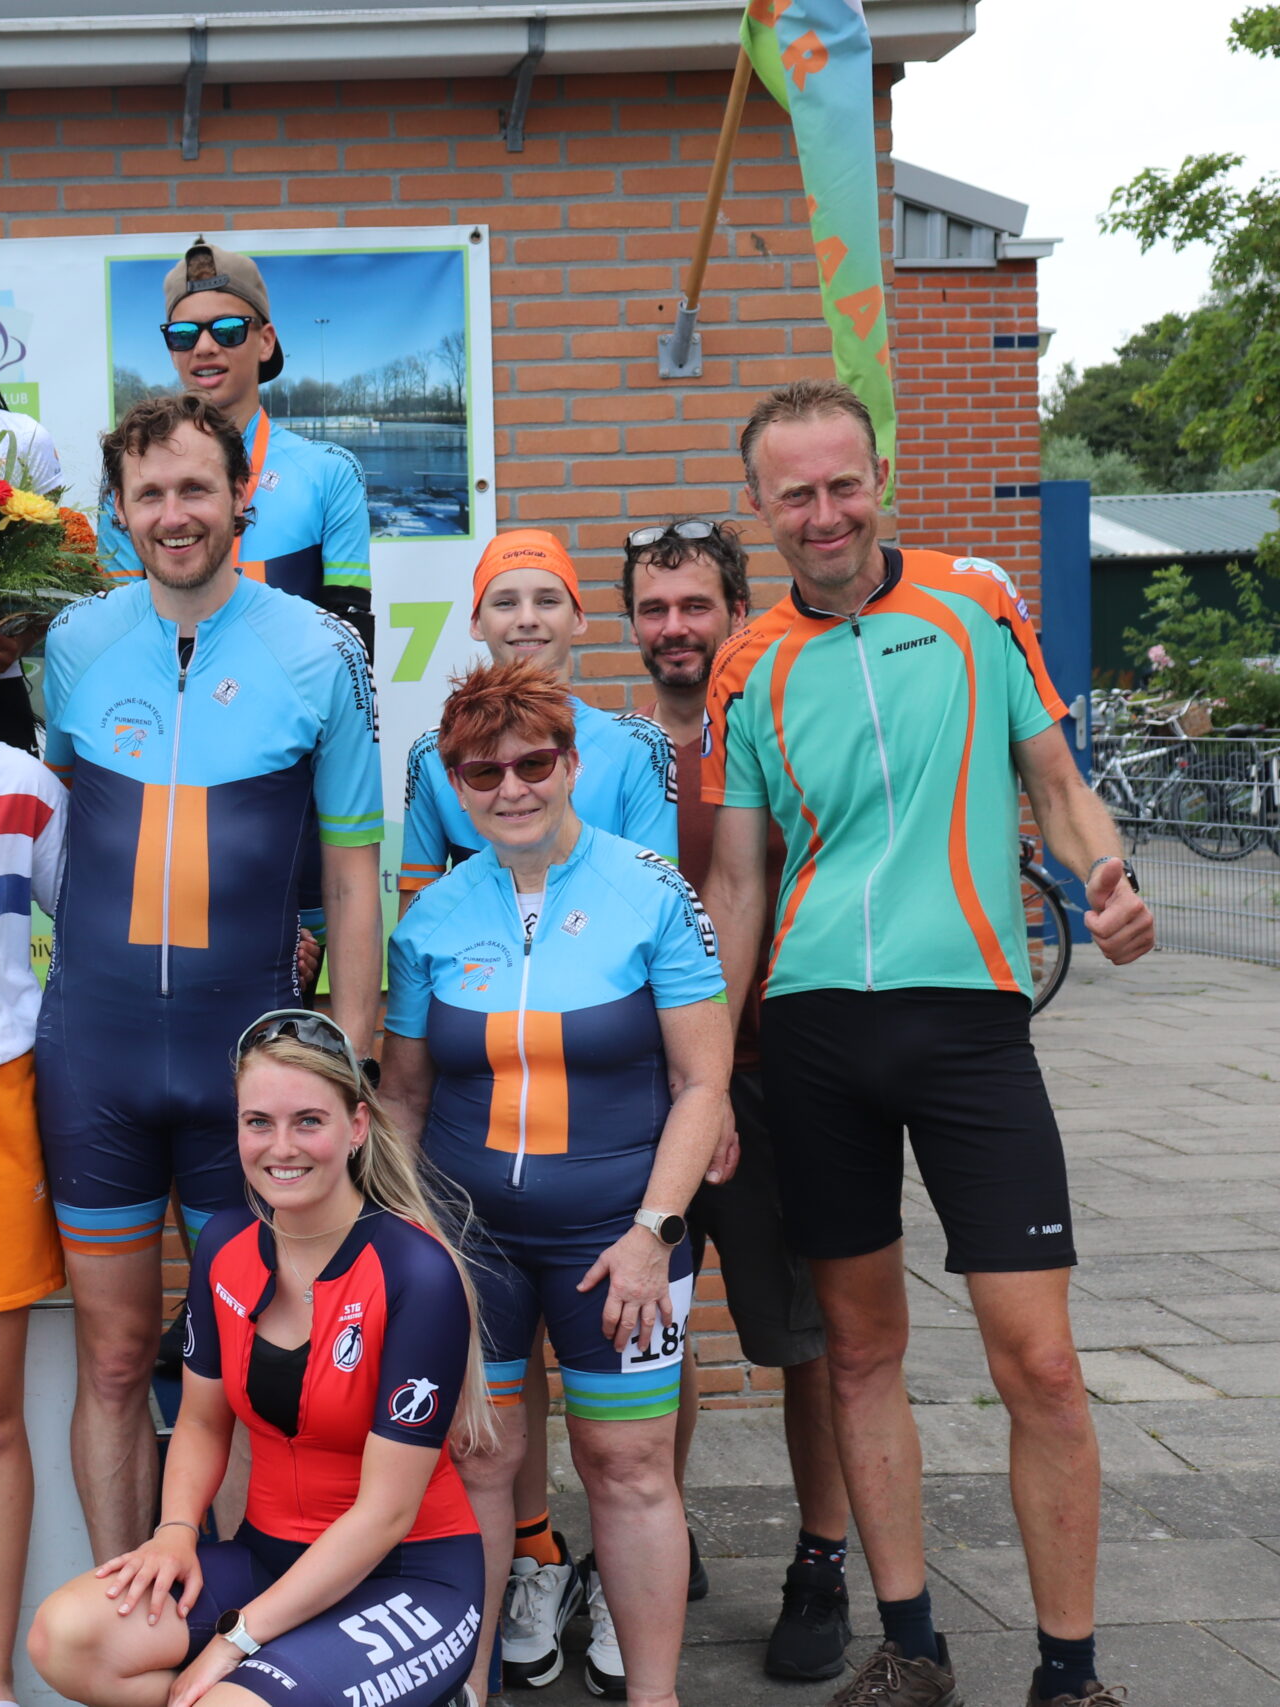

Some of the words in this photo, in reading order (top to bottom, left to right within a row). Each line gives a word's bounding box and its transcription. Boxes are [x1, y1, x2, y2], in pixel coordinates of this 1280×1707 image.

[896, 634, 937, 653] HUNTER
[332, 640, 366, 710] Achterveld
[114, 716, 152, 726] PURMEREND
[216, 1282, 247, 1318] FORTE
[344, 1302, 362, 1315] STG
[339, 1592, 443, 1666] STG
[343, 1604, 481, 1707] ZAANSTREEK
